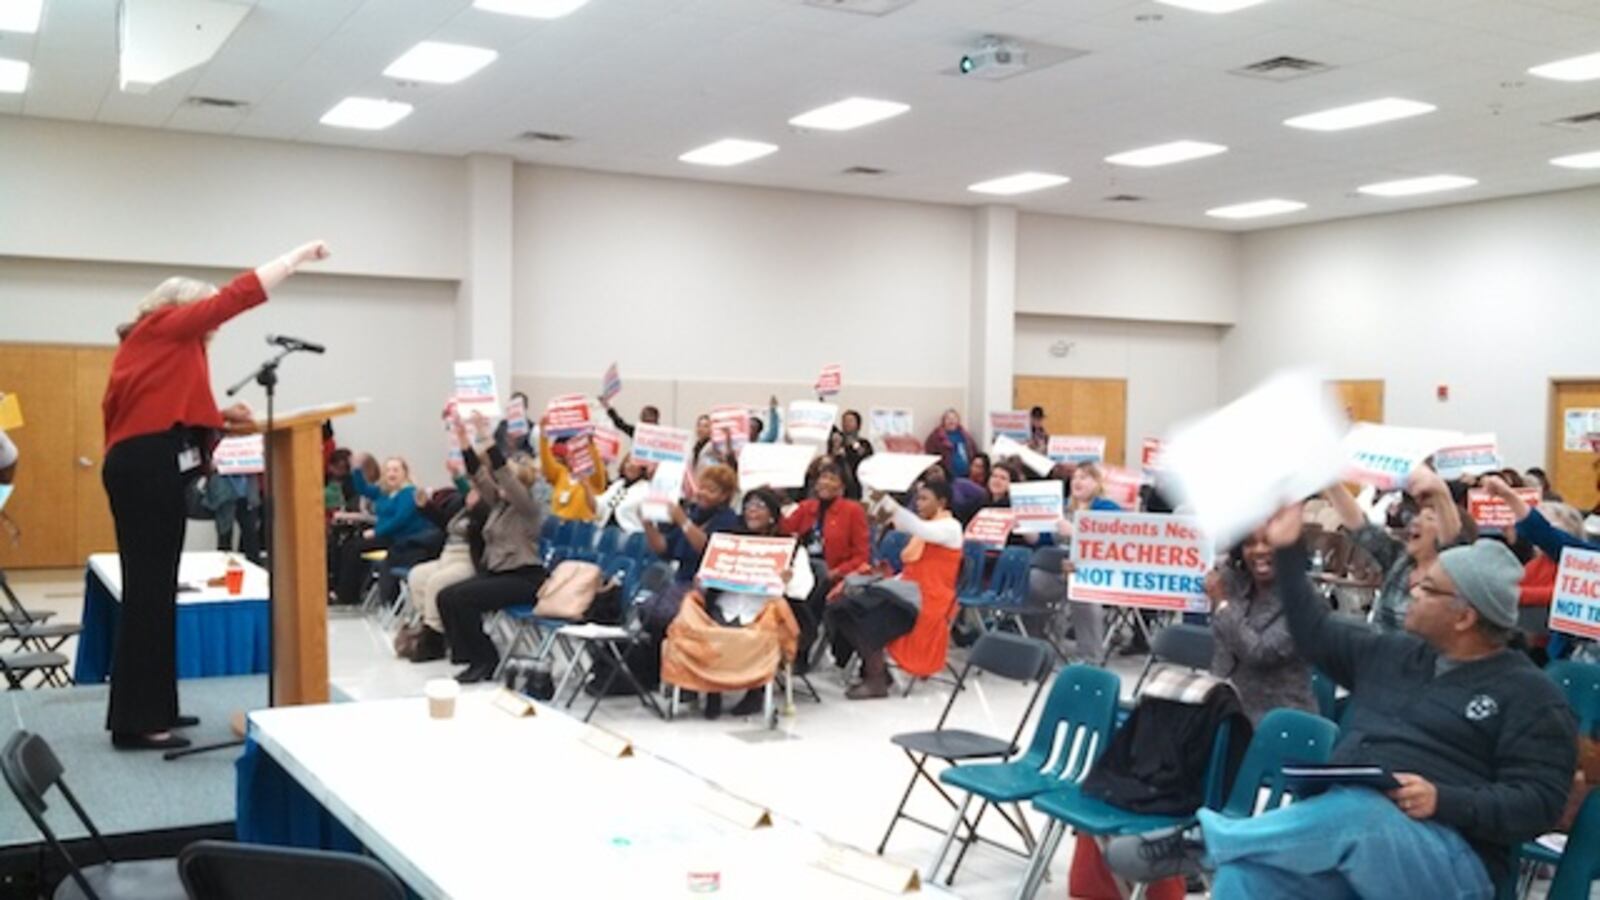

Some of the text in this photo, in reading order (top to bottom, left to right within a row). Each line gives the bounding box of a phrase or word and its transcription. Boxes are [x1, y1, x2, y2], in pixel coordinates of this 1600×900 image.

[1079, 516, 1159, 537] Students
[1077, 540, 1207, 571] TEACHERS,
[1075, 567, 1205, 595] NOT TESTERS
[1557, 599, 1583, 617] NOT
